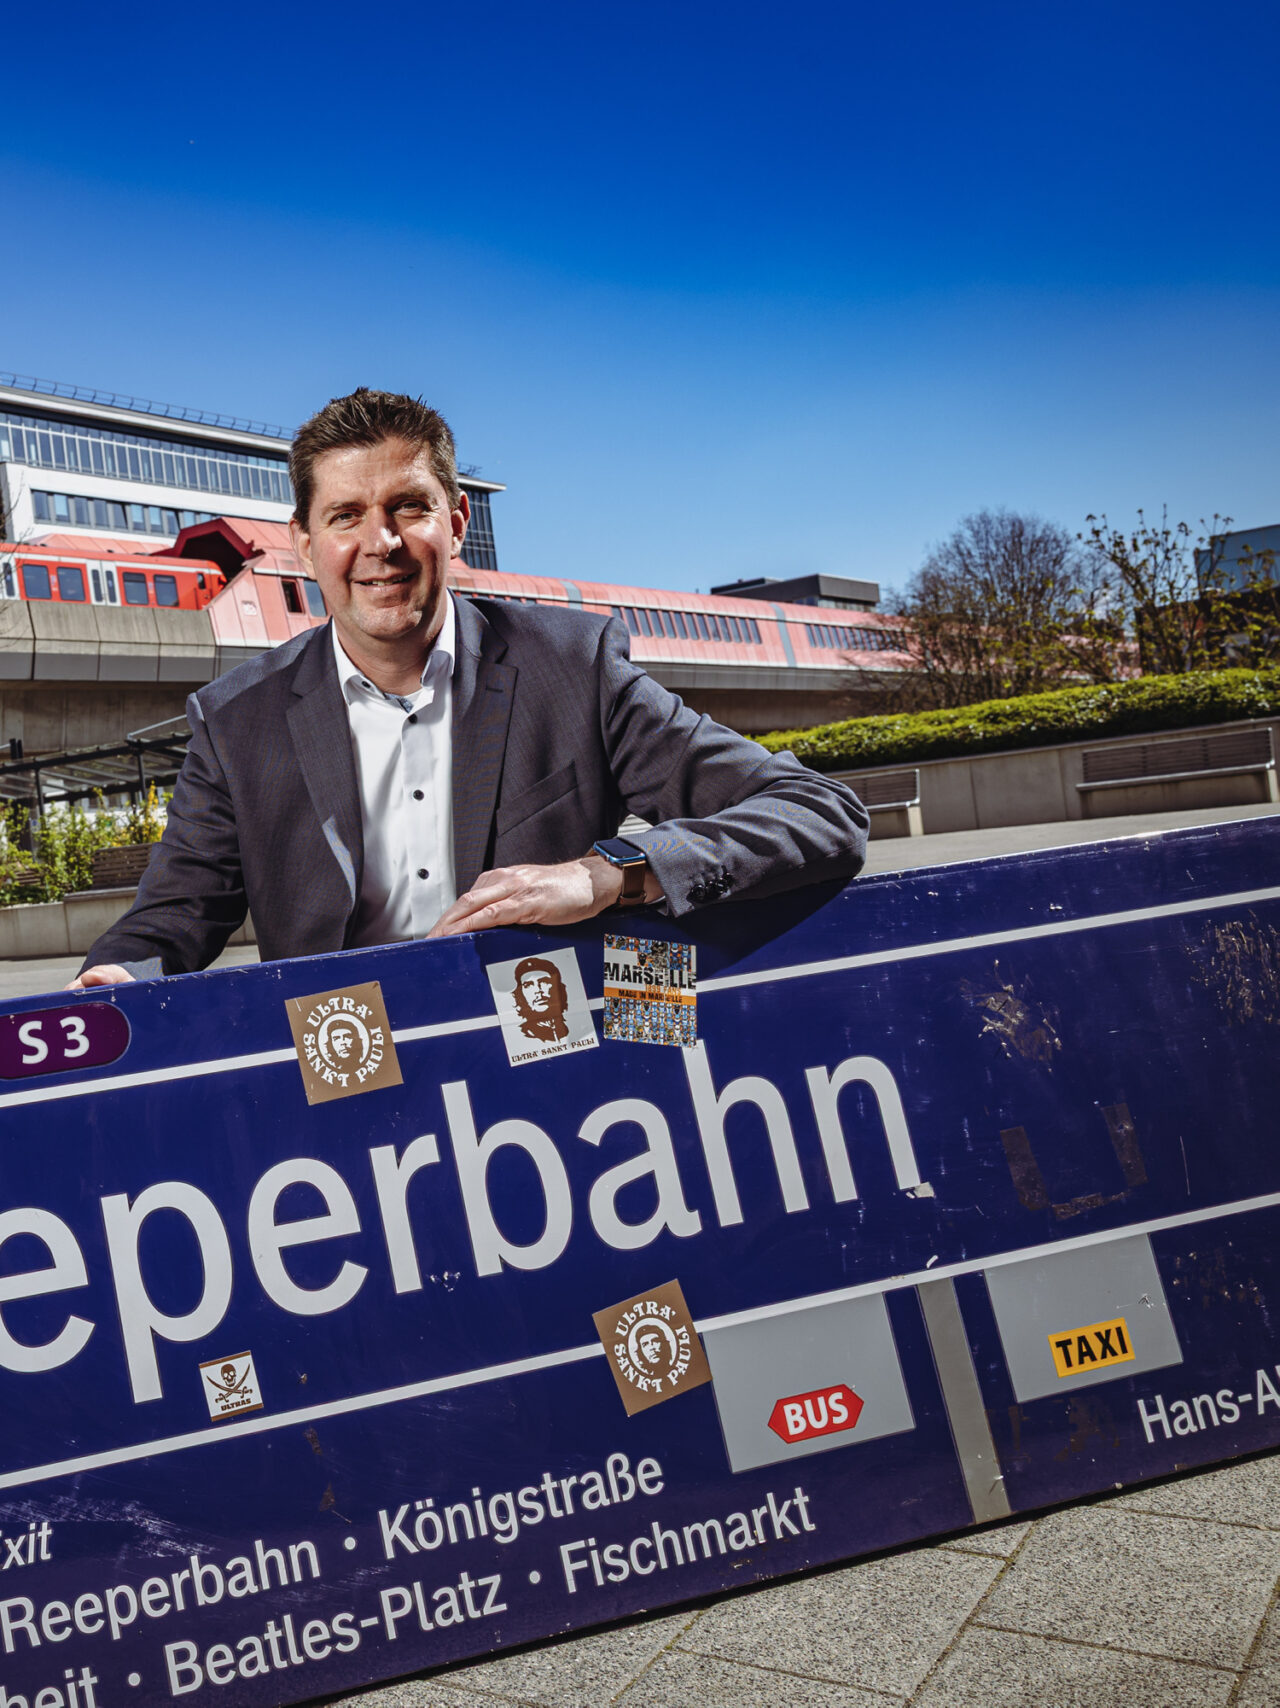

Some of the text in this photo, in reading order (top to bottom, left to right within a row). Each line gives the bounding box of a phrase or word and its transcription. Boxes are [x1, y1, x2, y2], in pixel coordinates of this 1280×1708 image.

[303, 1026, 384, 1088] SANKT PAULI
[614, 1325, 691, 1393] SANKT PAULI
[1056, 1325, 1130, 1370] TAXI
[221, 1397, 252, 1412] ULTRAS
[782, 1392, 850, 1437] BUS
[1137, 1364, 1280, 1444] Hans-A
[377, 1452, 664, 1560] Königstraße
[164, 1569, 507, 1696] Beatles-Platz
[560, 1487, 815, 1594] Fischmarkt
